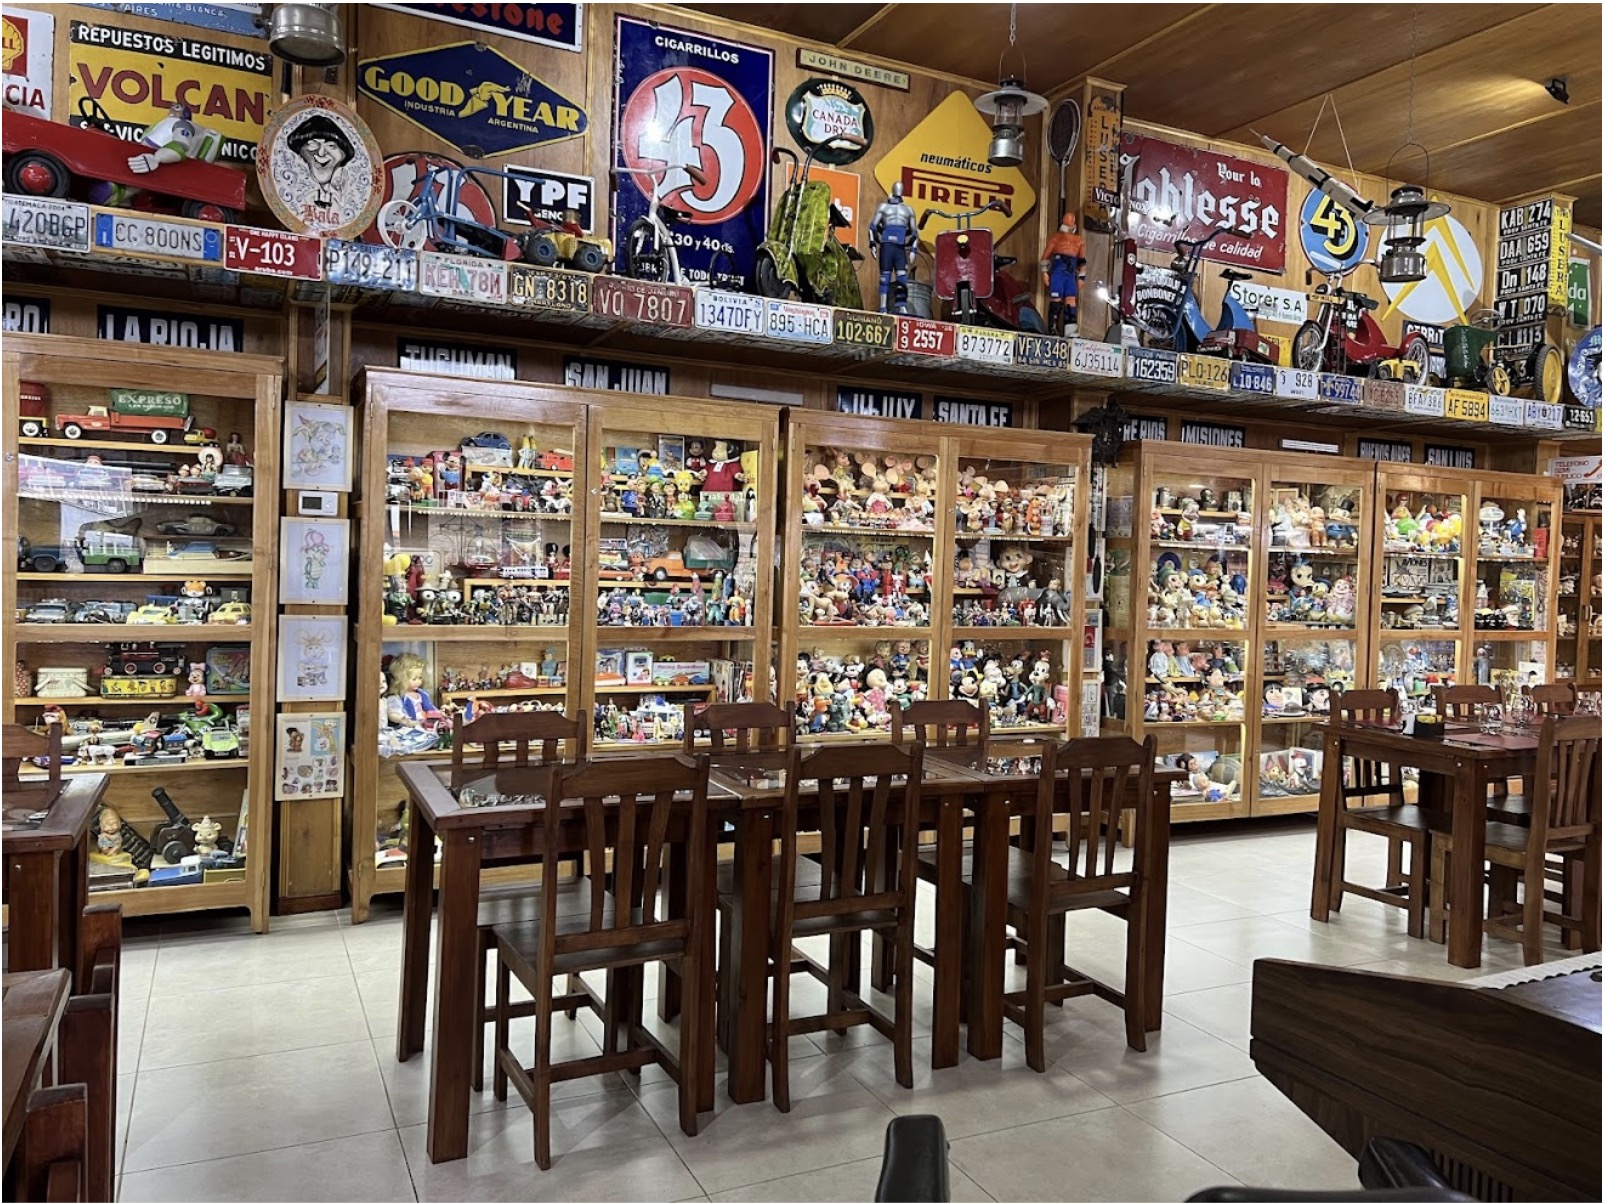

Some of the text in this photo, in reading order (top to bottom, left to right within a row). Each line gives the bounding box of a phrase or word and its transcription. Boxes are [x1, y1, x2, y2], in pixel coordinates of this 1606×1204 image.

[78, 24, 175, 54] REPUESTOS
[181, 39, 266, 71] LEGITIMOS
[654, 36, 740, 64] CIGARRILLOS
[808, 55, 902, 83] JOHN DEERE
[76, 62, 265, 125] VOLCAN
[364, 66, 581, 132] GOOD YEAR
[404, 99, 455, 117] INDUSTRIA
[812, 108, 858, 128] CANADA
[487, 117, 539, 134] ARGENTINA
[824, 123, 847, 136] DRY
[638, 73, 746, 213] 43
[920, 153, 994, 174] neumáticos
[1217, 162, 1246, 185] Pour
[514, 179, 588, 210] YPF
[1309, 194, 1356, 255] 43
[1500, 200, 1551, 231] KAB 274
[144, 227, 202, 253] 800NS
[235, 236, 296, 267] V-103
[702, 236, 721, 251] 40
[1219, 242, 1264, 263] calidad
[1500, 231, 1550, 261] DAA 659
[444, 256, 485, 268] FLORIDA
[1501, 263, 1547, 289] Dn 148
[546, 279, 588, 304] 8318
[713, 295, 748, 305] BOLIVIA
[1232, 283, 1279, 309] Storer
[1567, 281, 1587, 301] da
[633, 292, 687, 324] 7807
[700, 303, 762, 331] 1347DFY
[1522, 294, 1546, 316] 070
[913, 329, 944, 351] 2557
[961, 334, 1010, 357] 873772
[1017, 335, 1068, 360] VFX 348
[1074, 352, 1119, 372] 6J35114
[1134, 357, 1176, 382] 162359
[568, 362, 610, 390] SAN
[118, 394, 182, 406] EXPRESO
[1186, 425, 1244, 448] MISIONES
